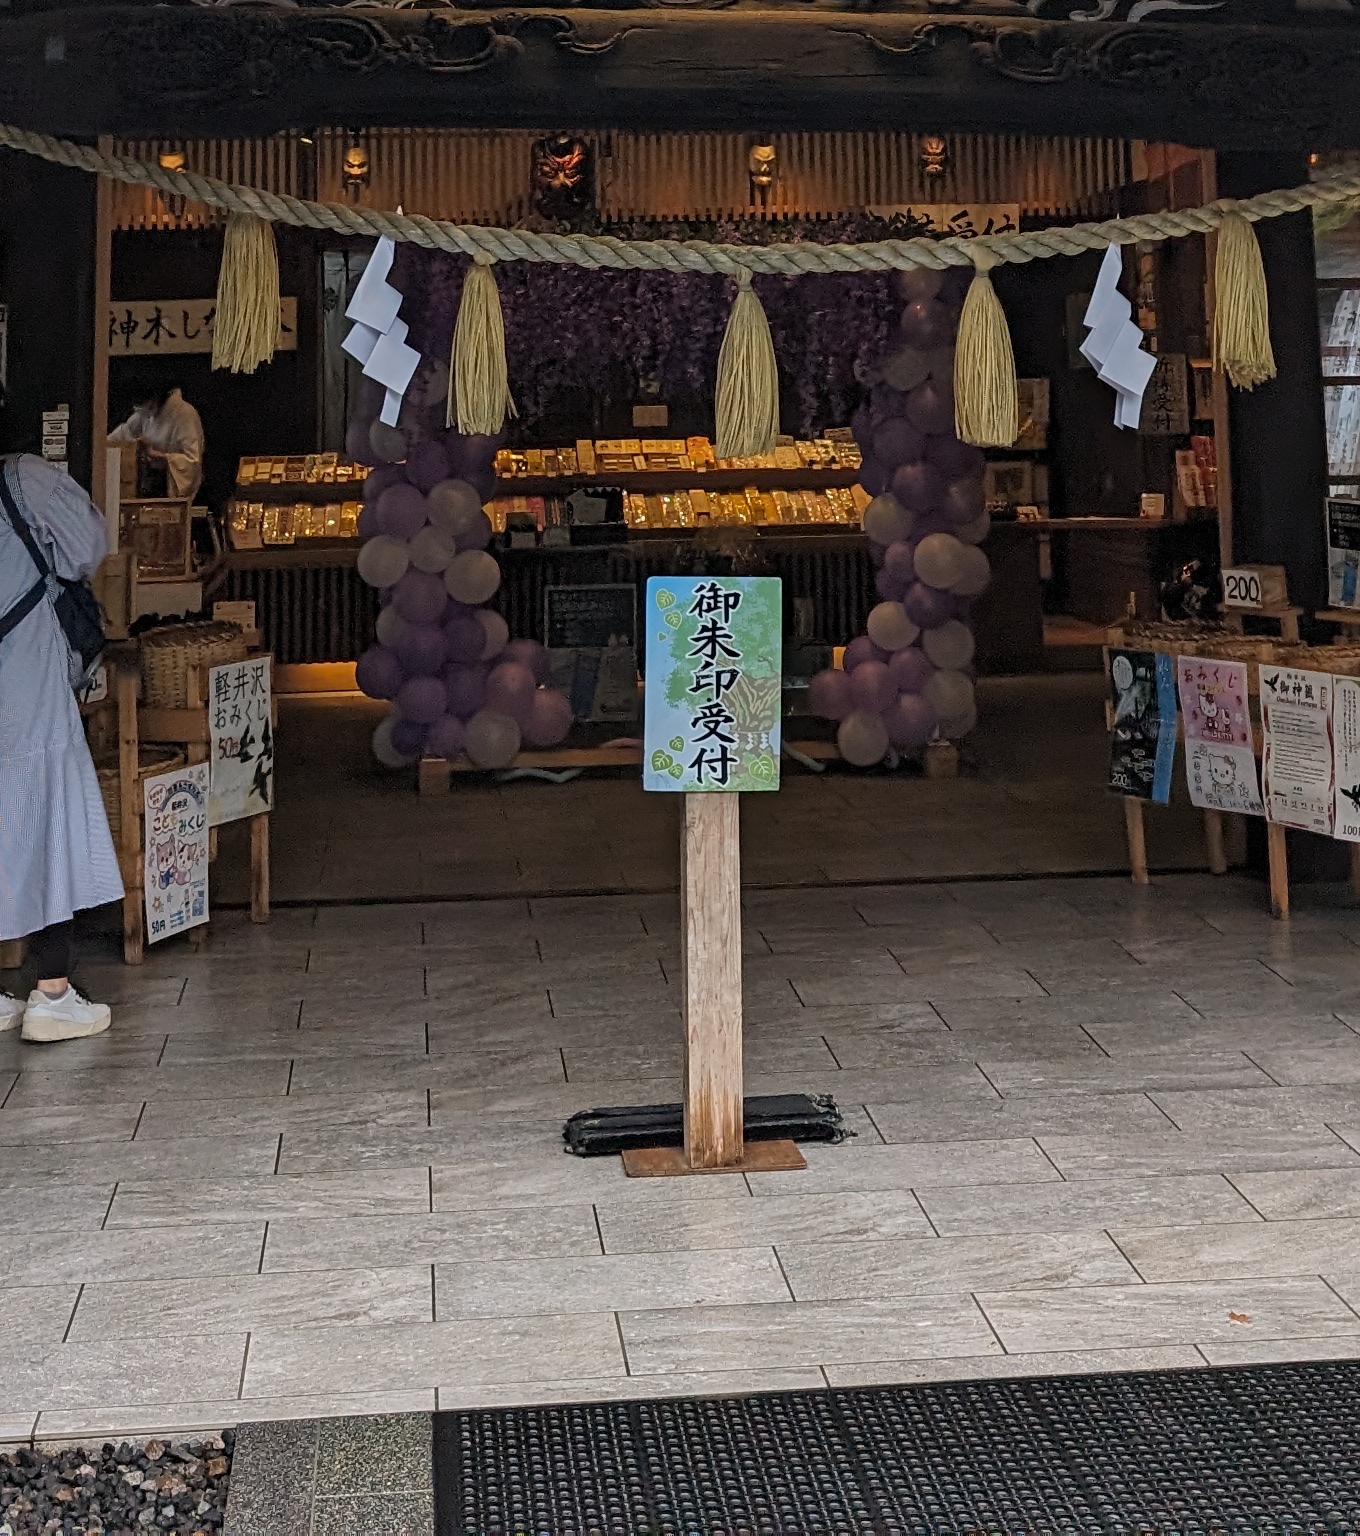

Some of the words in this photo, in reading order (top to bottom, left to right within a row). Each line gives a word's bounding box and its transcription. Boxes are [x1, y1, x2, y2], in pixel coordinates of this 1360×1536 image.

[214, 664, 266, 705] 軽井沢
[688, 581, 742, 785] 御朱印受付
[214, 697, 267, 730] おみくじ
